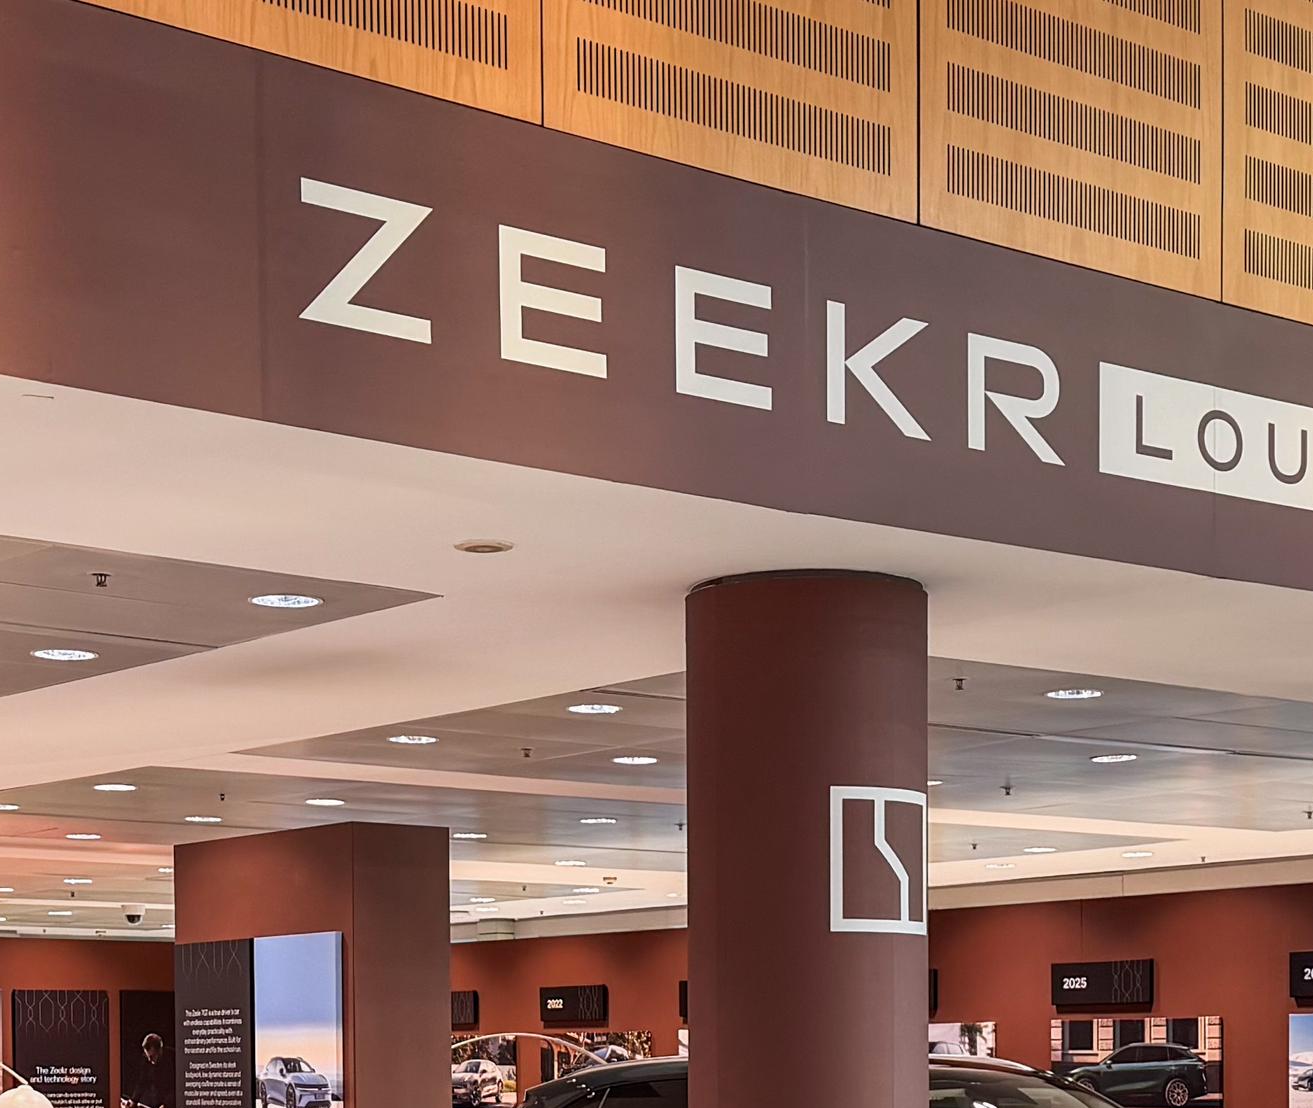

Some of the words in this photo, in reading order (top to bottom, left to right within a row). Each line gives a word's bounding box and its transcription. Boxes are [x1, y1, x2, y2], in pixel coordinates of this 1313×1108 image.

[299, 177, 1065, 465] ZEEKR
[1062, 976, 1088, 989] 2025
[547, 998, 564, 1009] 2022
